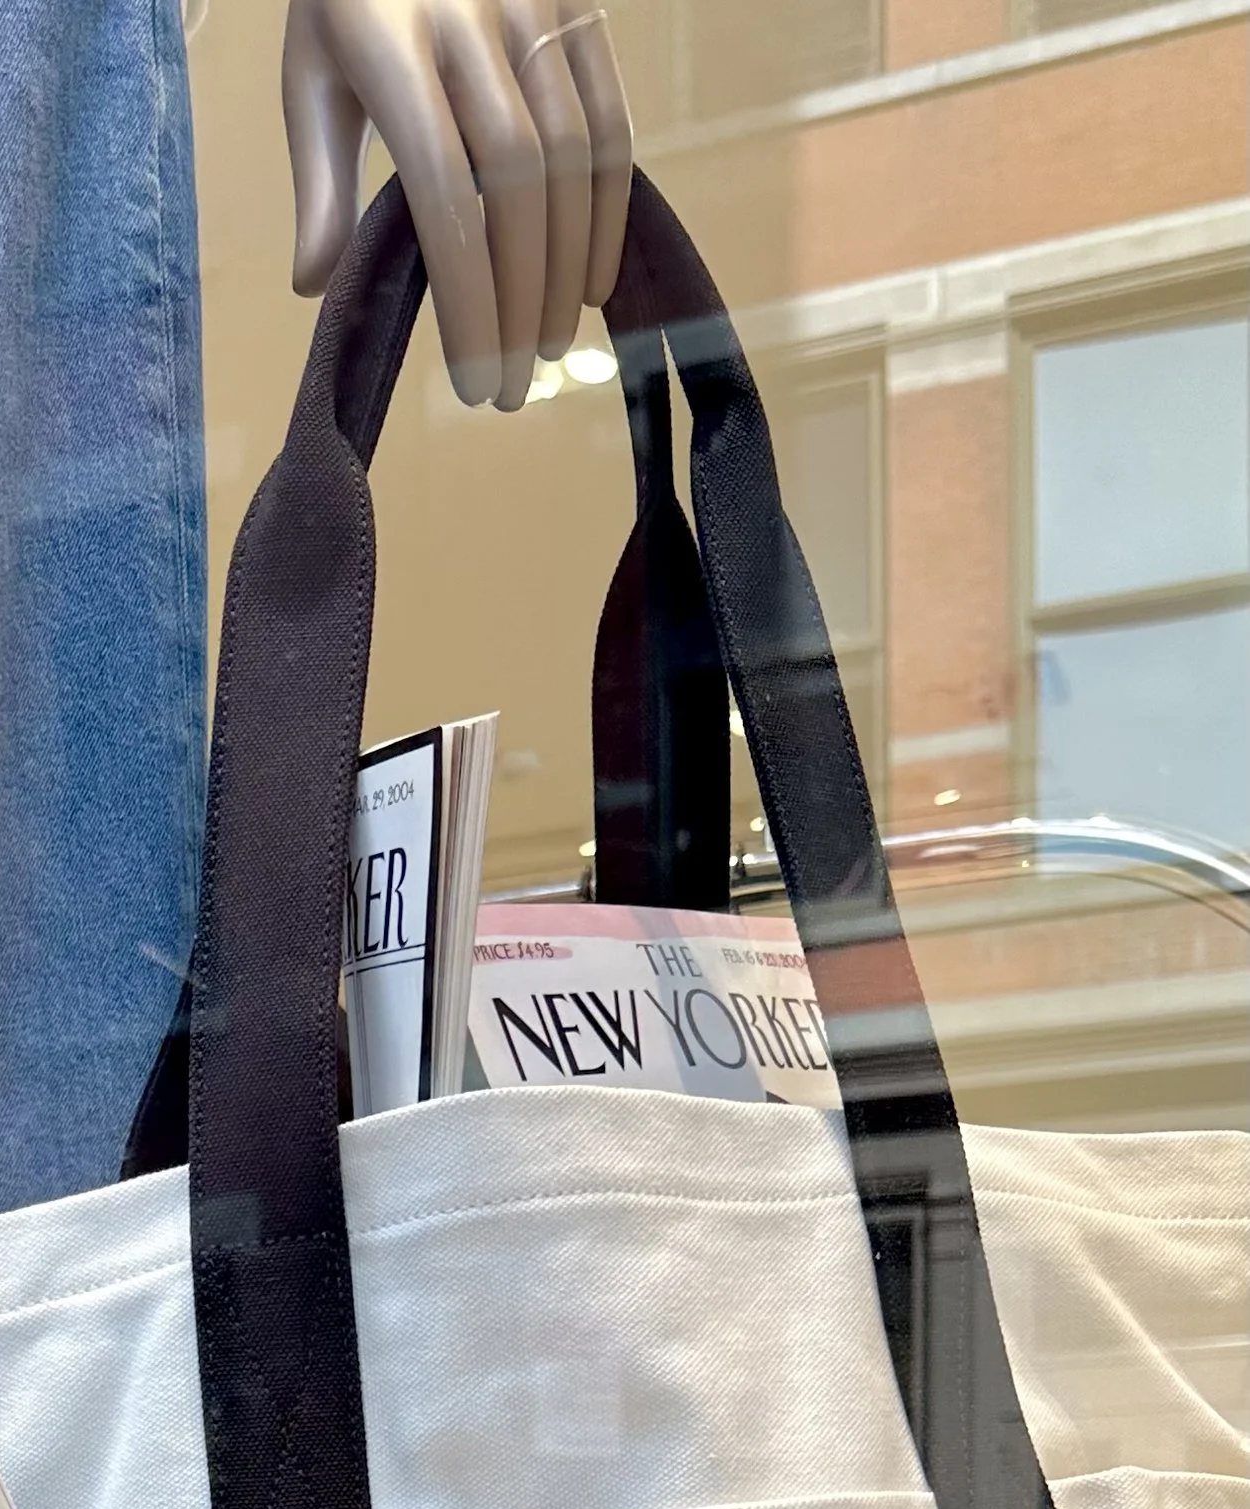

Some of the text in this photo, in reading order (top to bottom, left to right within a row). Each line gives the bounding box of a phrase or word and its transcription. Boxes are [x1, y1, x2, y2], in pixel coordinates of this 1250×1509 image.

[387, 780, 414, 806] 2004
[473, 943, 515, 962] PRICE
[636, 943, 701, 977] THE
[492, 989, 643, 1081] NEW
